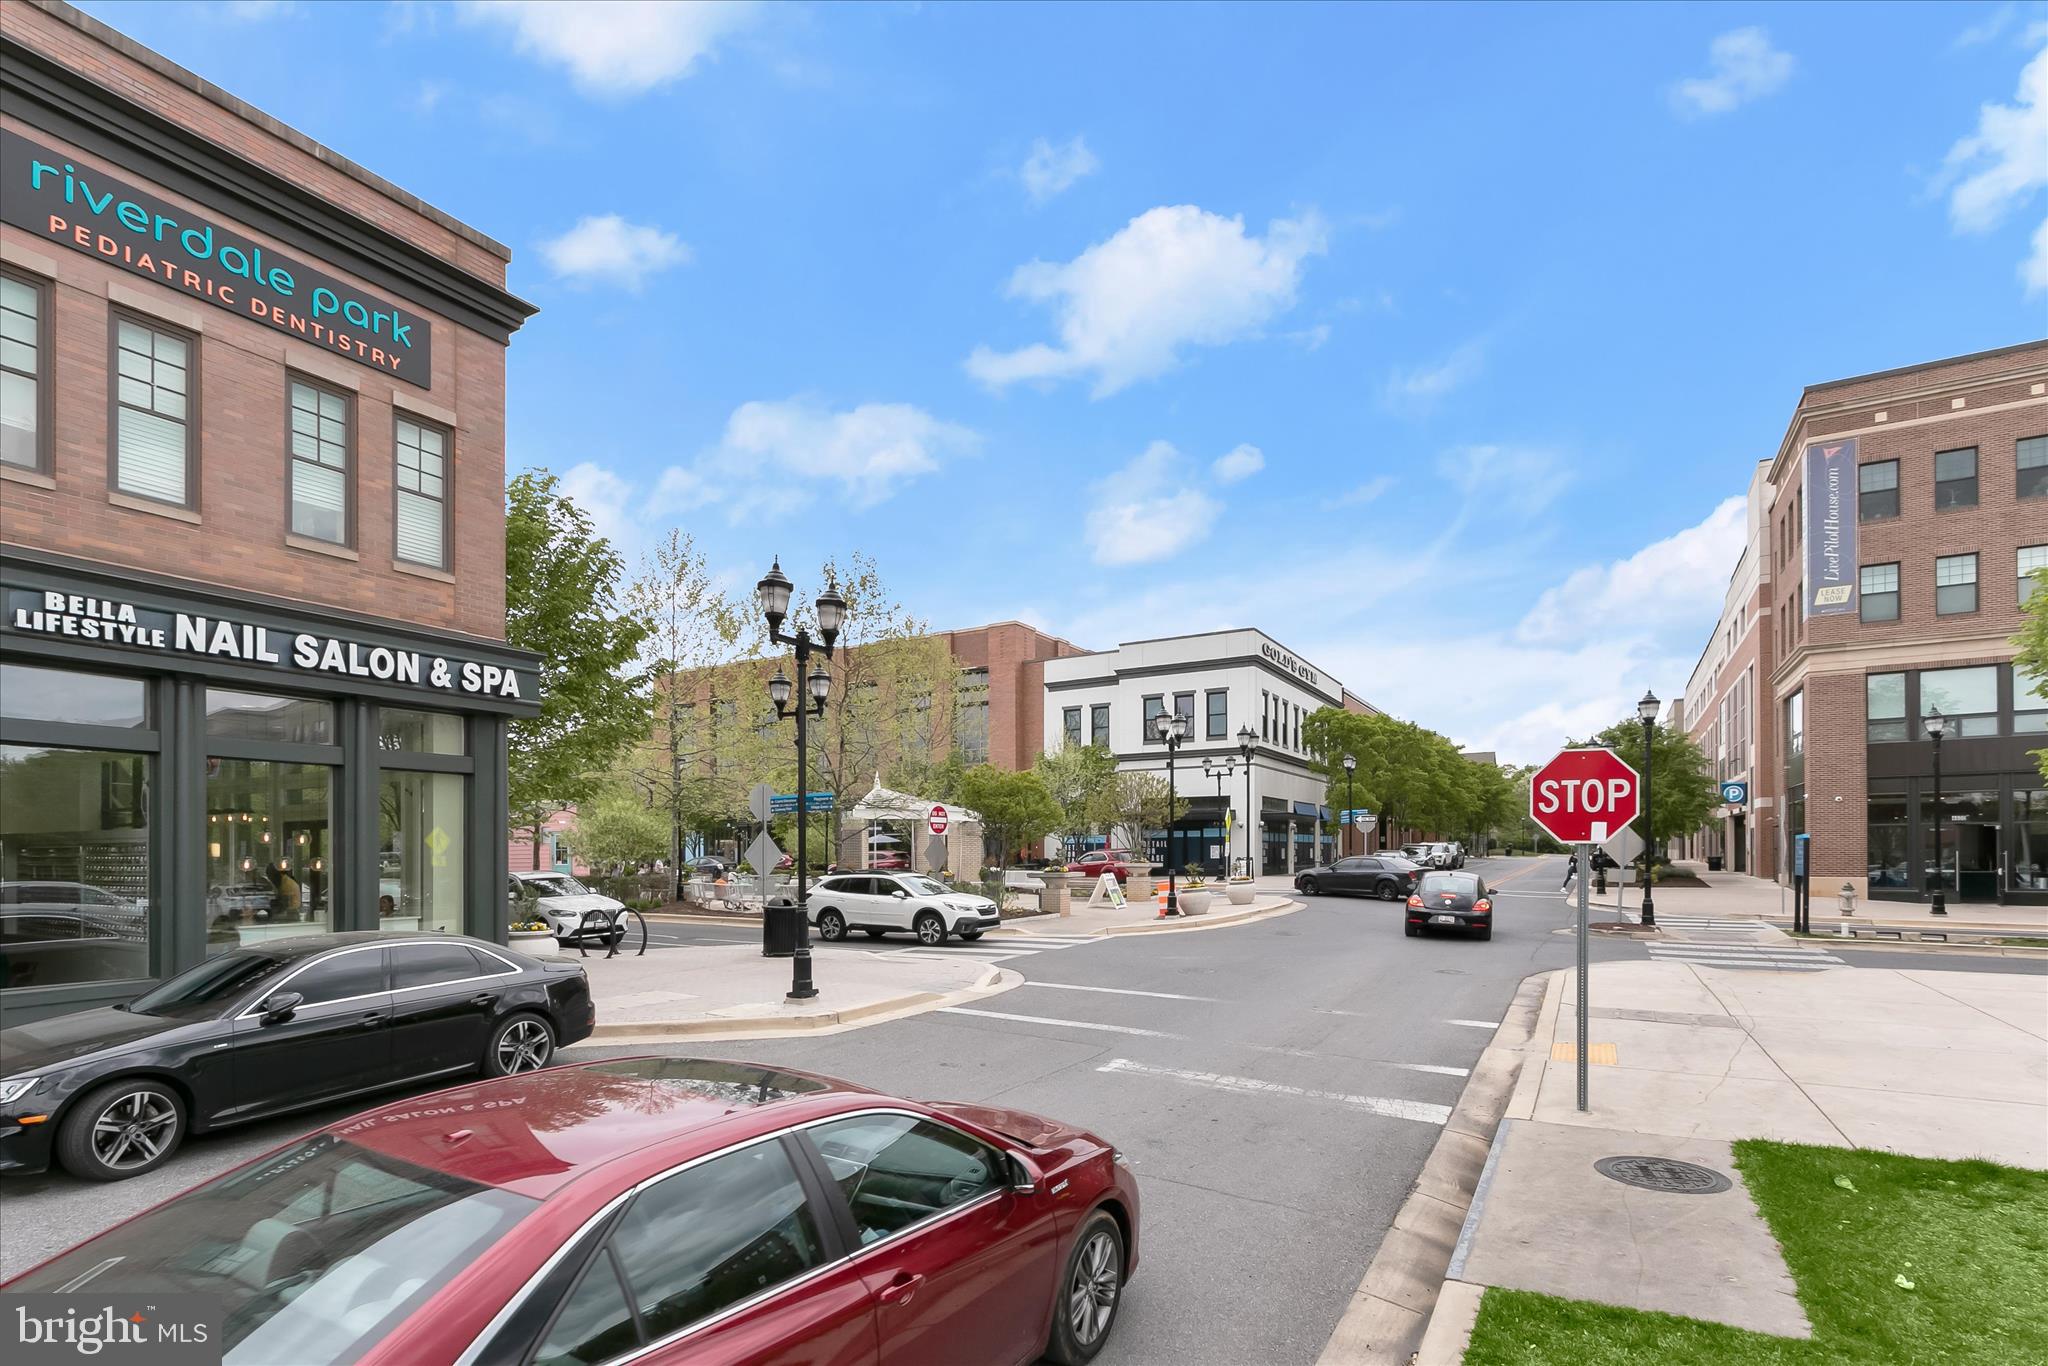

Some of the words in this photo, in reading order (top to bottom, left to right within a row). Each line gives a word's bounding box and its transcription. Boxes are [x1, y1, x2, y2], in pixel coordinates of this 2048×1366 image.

[31, 159, 296, 297] riverdale
[311, 286, 412, 348] park
[48, 214, 235, 304] PEDIATRIC
[250, 297, 402, 370] DENTISTRY
[45, 591, 137, 624] BELLA
[1820, 588, 1846, 597] LEASE
[1823, 595, 1843, 603] NOW
[15, 608, 166, 648] LIFESTYLE
[175, 613, 279, 663] NAIL
[294, 634, 420, 684] SALON
[430, 657, 452, 688] &
[461, 662, 521, 698] SPA
[1262, 643, 1297, 672] GOLD'S
[1298, 665, 1317, 685] GYM
[1538, 778, 1631, 813] STOP
